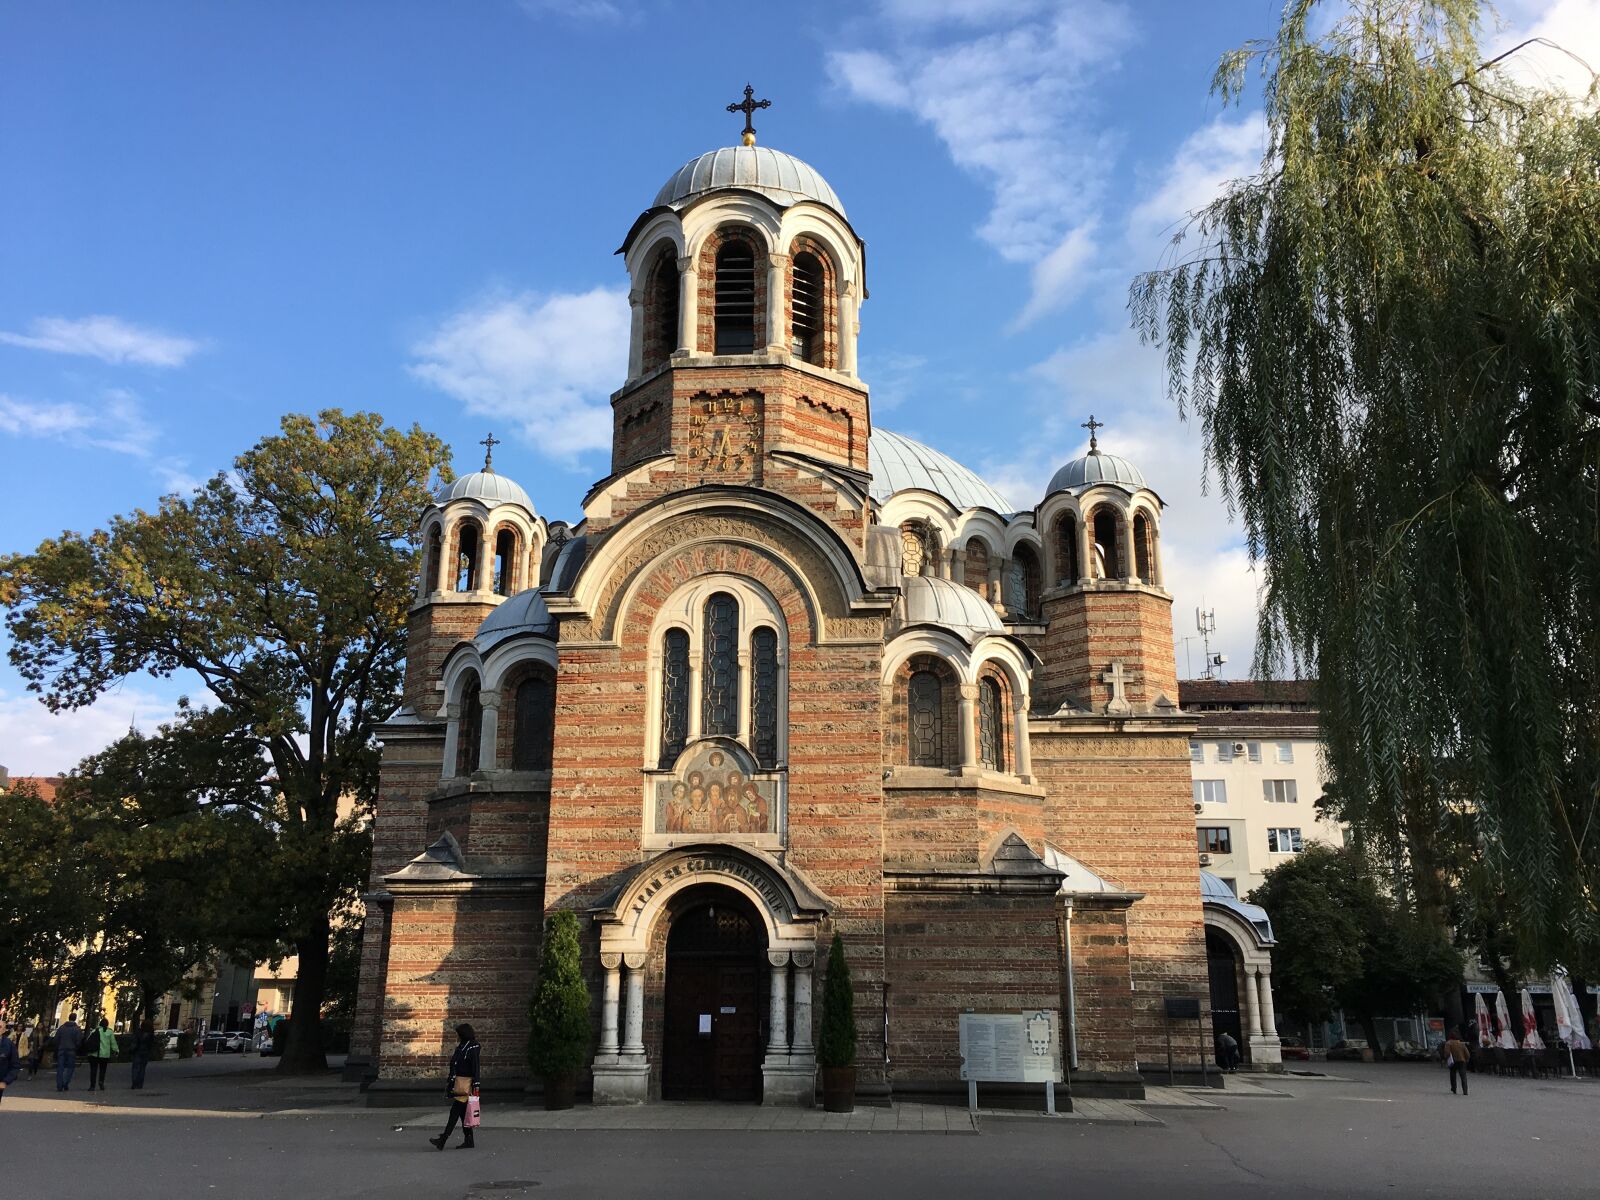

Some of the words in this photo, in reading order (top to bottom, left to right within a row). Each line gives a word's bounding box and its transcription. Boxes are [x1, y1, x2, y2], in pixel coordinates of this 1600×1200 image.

[708, 402, 717, 411] 11
[724, 398, 733, 408] 12
[740, 400, 744, 411] 1
[695, 415, 703, 425] 10
[752, 412, 758, 423] 2
[755, 427, 761, 440] 3
[751, 442, 757, 453] 4
[632, 877, 663, 914] ХРАМ
